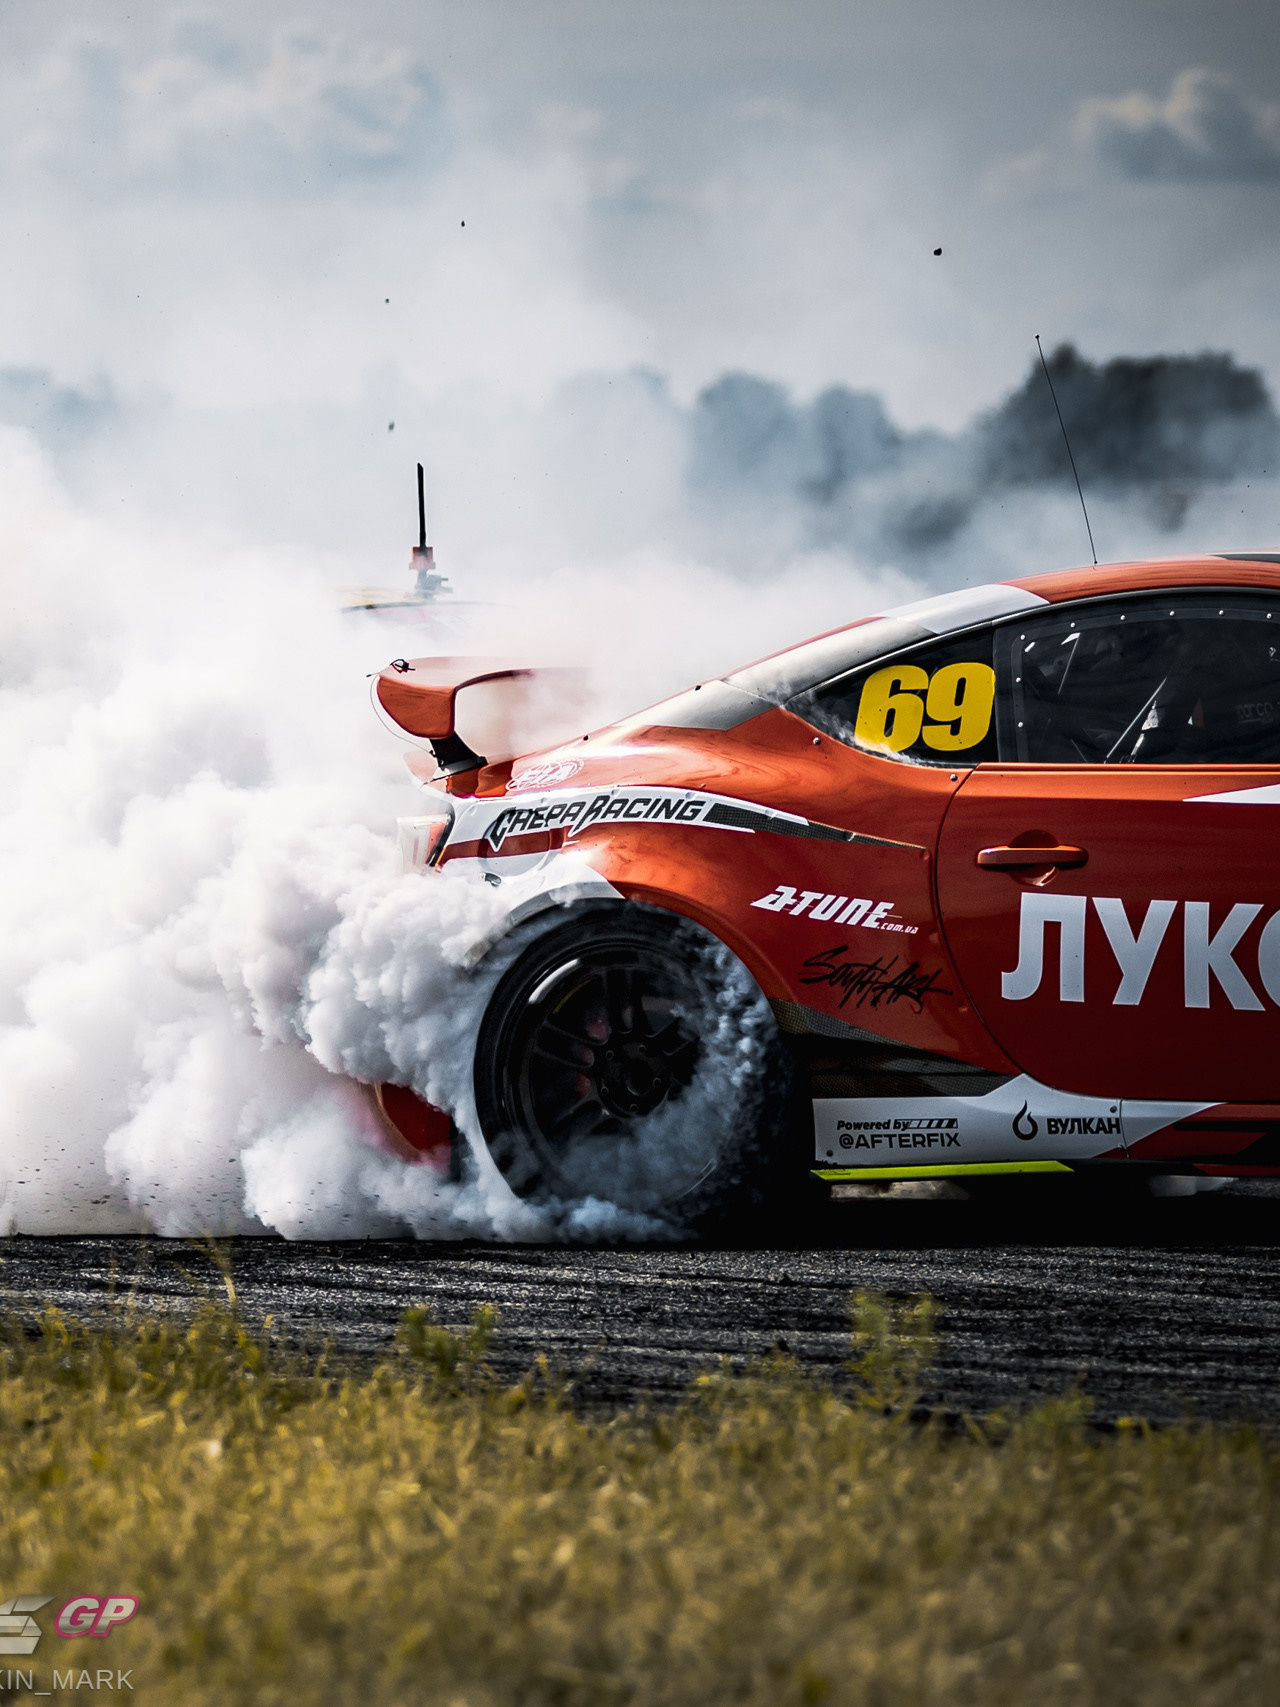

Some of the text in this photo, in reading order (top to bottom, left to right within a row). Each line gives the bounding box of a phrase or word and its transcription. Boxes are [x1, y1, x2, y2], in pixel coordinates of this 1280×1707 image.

[854, 662, 996, 752] 69
[1001, 892, 1280, 1011] ЛУК
[837, 1119, 910, 1131] Powered by
[1046, 1117, 1121, 1135] ВУЛКАН
[839, 1133, 961, 1149] @AFTERFIX
